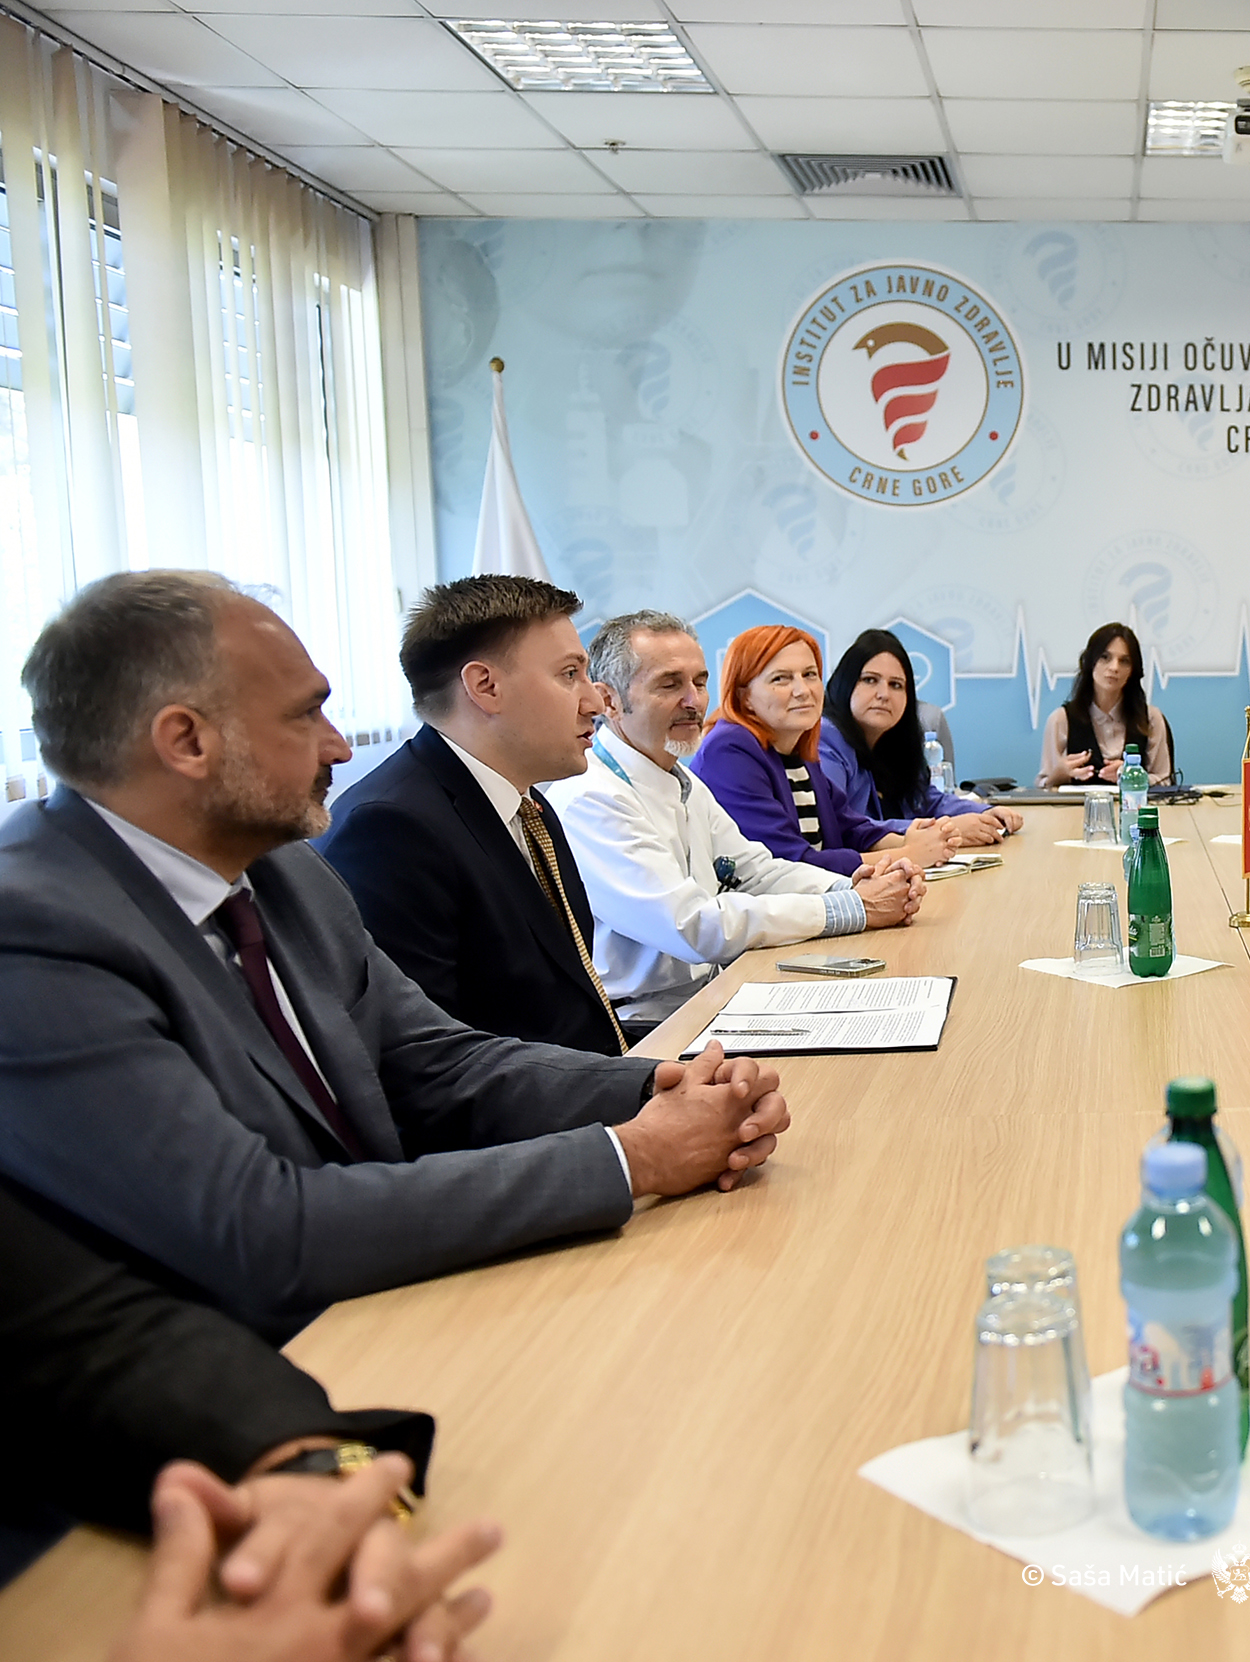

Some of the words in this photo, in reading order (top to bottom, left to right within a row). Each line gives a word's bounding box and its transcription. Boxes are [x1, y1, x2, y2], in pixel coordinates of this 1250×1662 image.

[792, 295, 847, 387] INSTITUT
[849, 279, 878, 303] ZA
[886, 274, 950, 303] JAVNO
[953, 295, 1015, 389] ZDRAVLJE
[1056, 341, 1072, 371] U
[1086, 341, 1170, 372] MISIJI
[848, 465, 900, 497] CRNE
[912, 464, 965, 497] GORE
